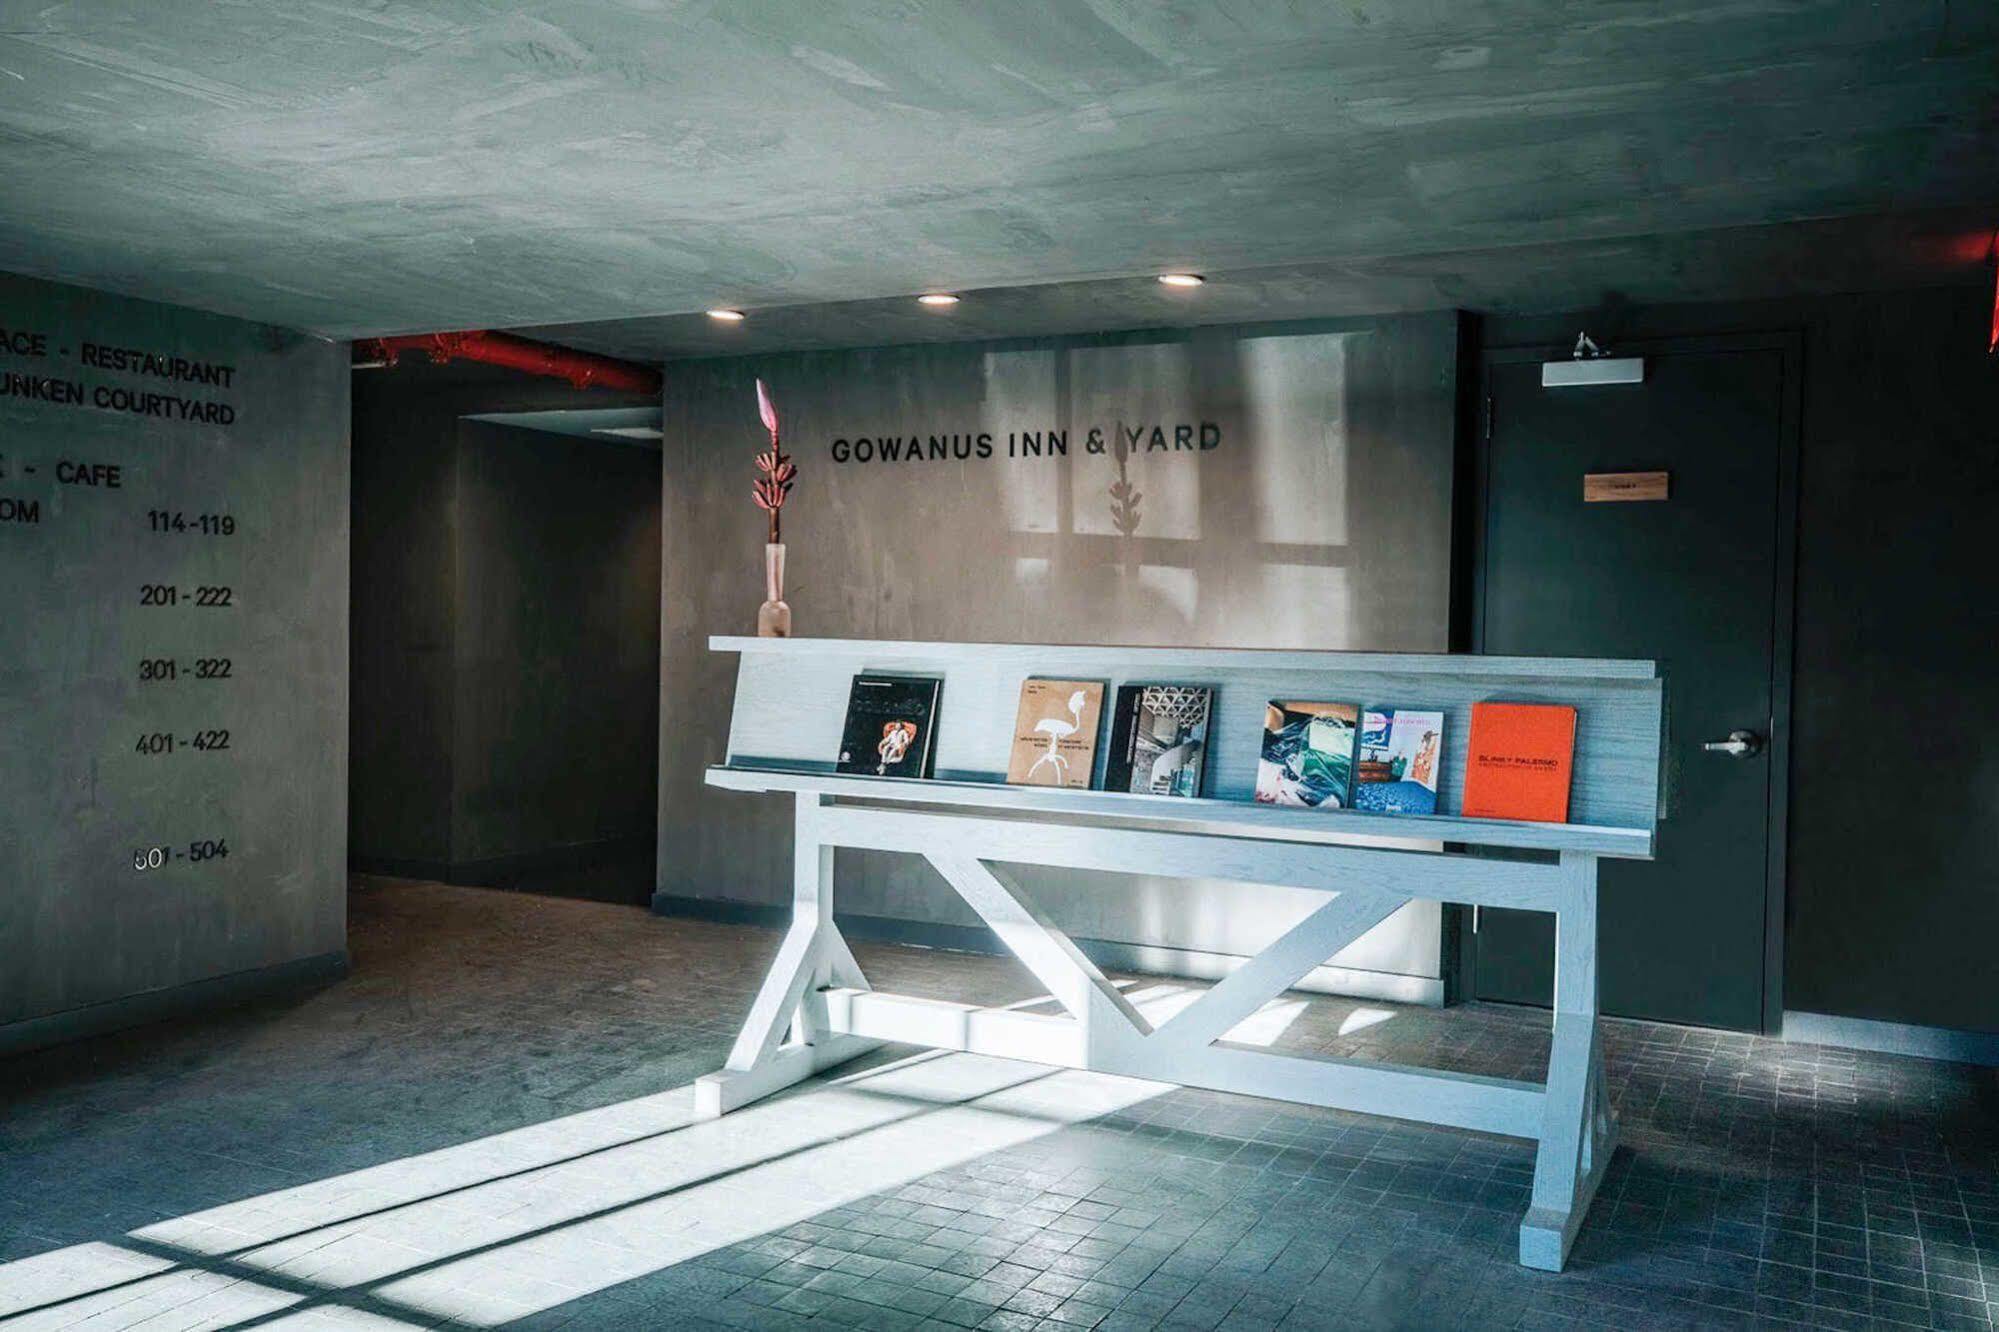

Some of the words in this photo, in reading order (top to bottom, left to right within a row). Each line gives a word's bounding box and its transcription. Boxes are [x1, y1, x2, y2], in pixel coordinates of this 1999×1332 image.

[81, 343, 236, 388] RESTAURANT
[94, 386, 235, 425] COURTYARD
[832, 433, 993, 463] GOWANUS
[1009, 430, 1067, 457] INN
[1086, 427, 1106, 454] &
[1125, 422, 1221, 453] YARD
[57, 461, 121, 488] CAFE
[147, 510, 234, 535] 114-119
